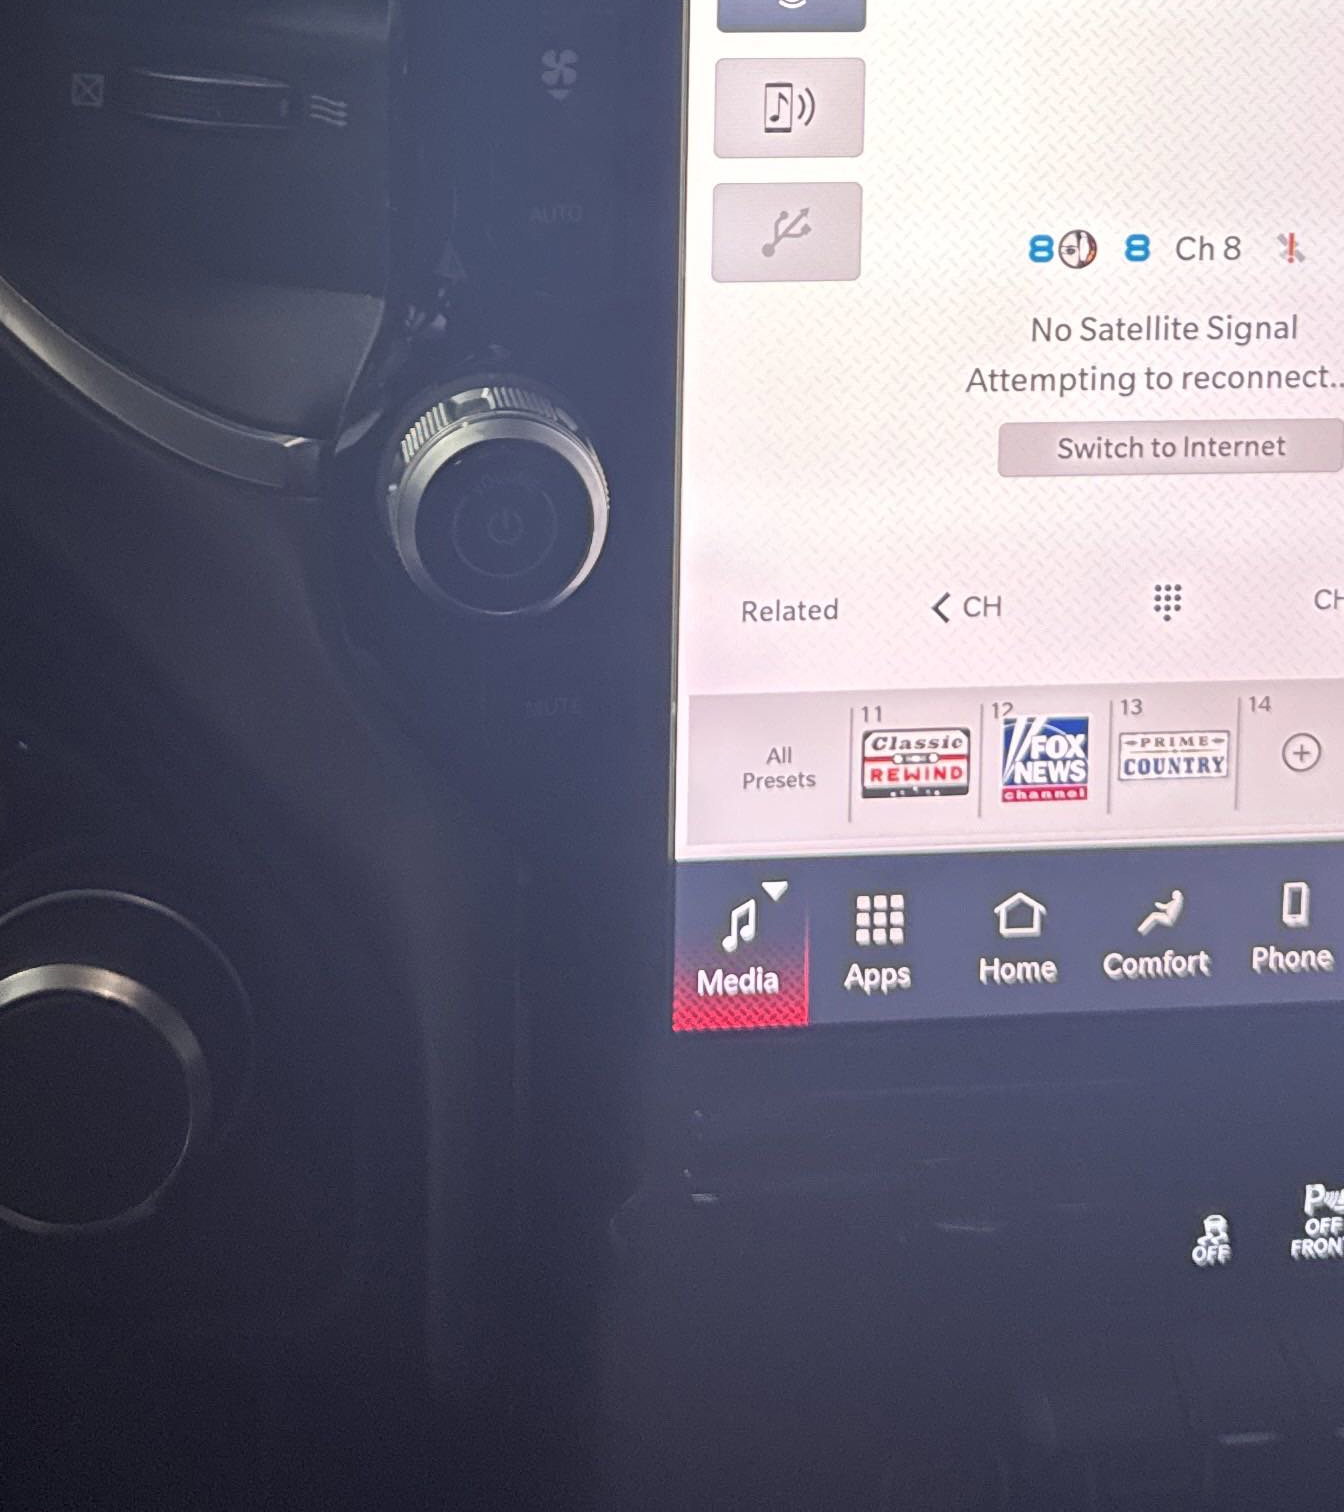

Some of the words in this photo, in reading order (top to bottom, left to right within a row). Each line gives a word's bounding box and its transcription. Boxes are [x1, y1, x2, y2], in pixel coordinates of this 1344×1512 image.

[1124, 233, 1150, 262] 8
[1176, 235, 1215, 261] Ch
[1223, 235, 1242, 261] 8
[1031, 317, 1072, 342] No
[1080, 315, 1200, 342] Satellite
[1207, 314, 1299, 346] Signal
[965, 366, 1137, 397] Attempting
[1145, 368, 1174, 390] to
[1057, 437, 1144, 459] Switch
[1151, 437, 1177, 458] to
[1184, 436, 1287, 458] Internet
[742, 598, 839, 623] Related
[962, 596, 1003, 618] CH
[861, 706, 883, 722] 11
[991, 702, 1013, 719] 12
[1120, 699, 1143, 716] 13
[1248, 696, 1272, 713] 14
[871, 733, 964, 753] Classic
[1030, 734, 1086, 759] FOX
[1140, 735, 1210, 749] PRIME
[766, 747, 793, 765] All
[1123, 756, 1226, 776] COUNTRY
[743, 770, 816, 790] Presets
[870, 766, 964, 783] REWIND
[1014, 759, 1087, 785] NEWS
[1003, 787, 1087, 802] channel
[1102, 950, 1211, 979] Comfort
[1252, 946, 1335, 974] Phone
[697, 967, 780, 996] Media
[843, 963, 912, 995] Apps
[979, 958, 1058, 985] Home
[1305, 1216, 1344, 1237] OFF
[1192, 1244, 1232, 1266] OFF
